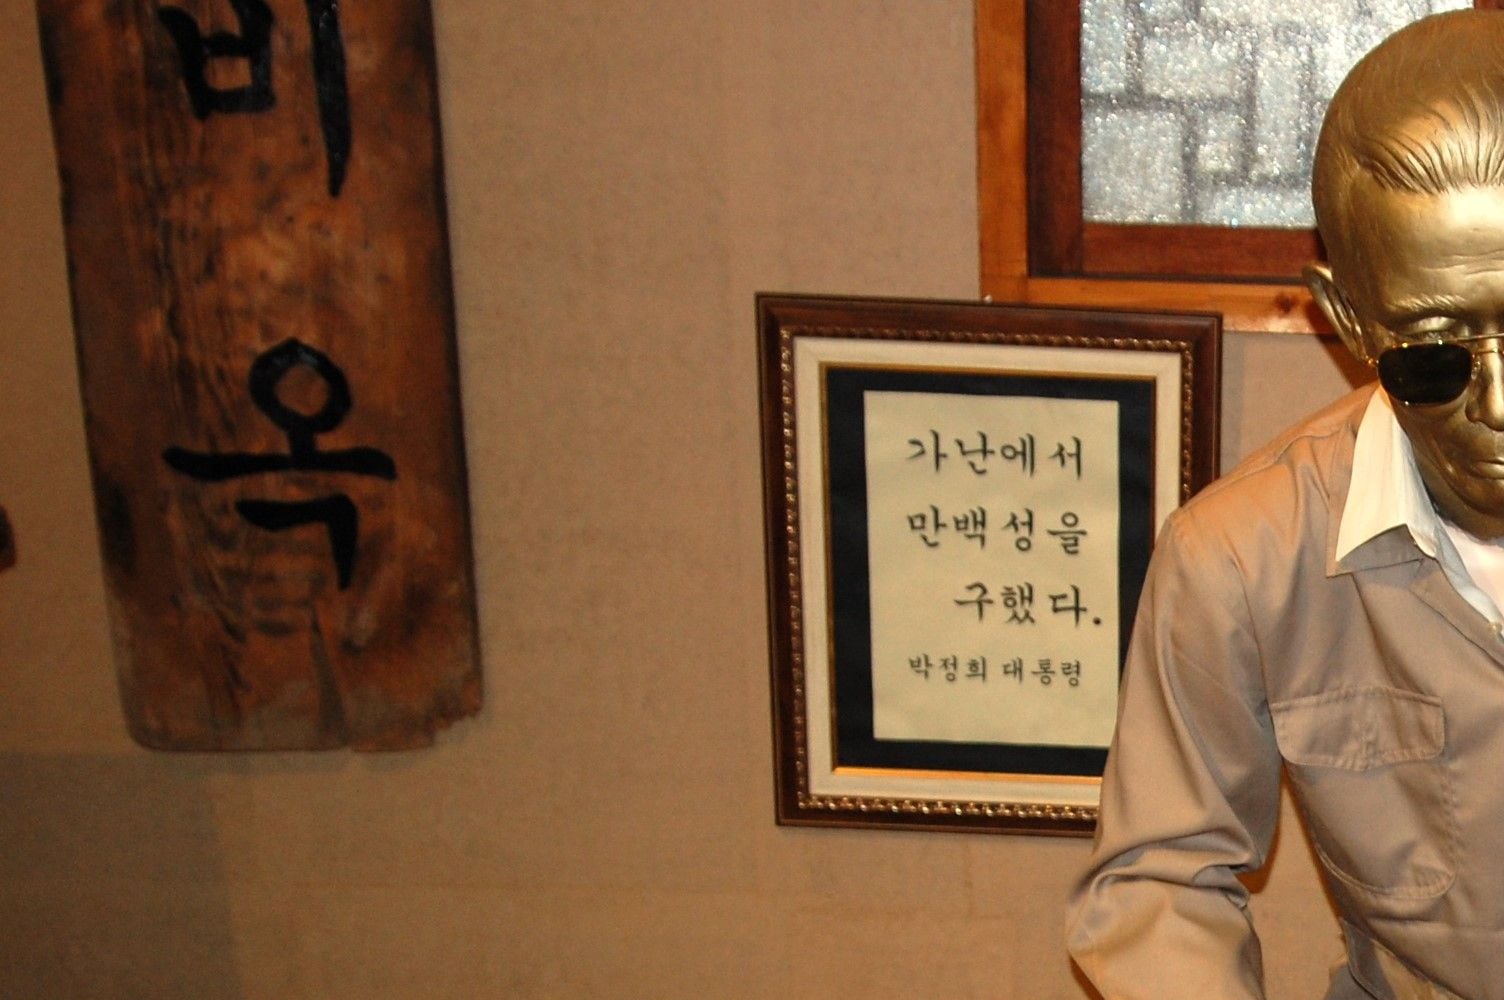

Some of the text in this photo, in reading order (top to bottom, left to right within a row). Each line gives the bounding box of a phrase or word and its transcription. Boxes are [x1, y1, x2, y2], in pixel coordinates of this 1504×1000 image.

[909, 429, 1082, 478] 가난에서
[907, 505, 1087, 555] 만백성을
[955, 582, 1101, 626] 구했다.
[909, 654, 1081, 687] 박정희 대통령
